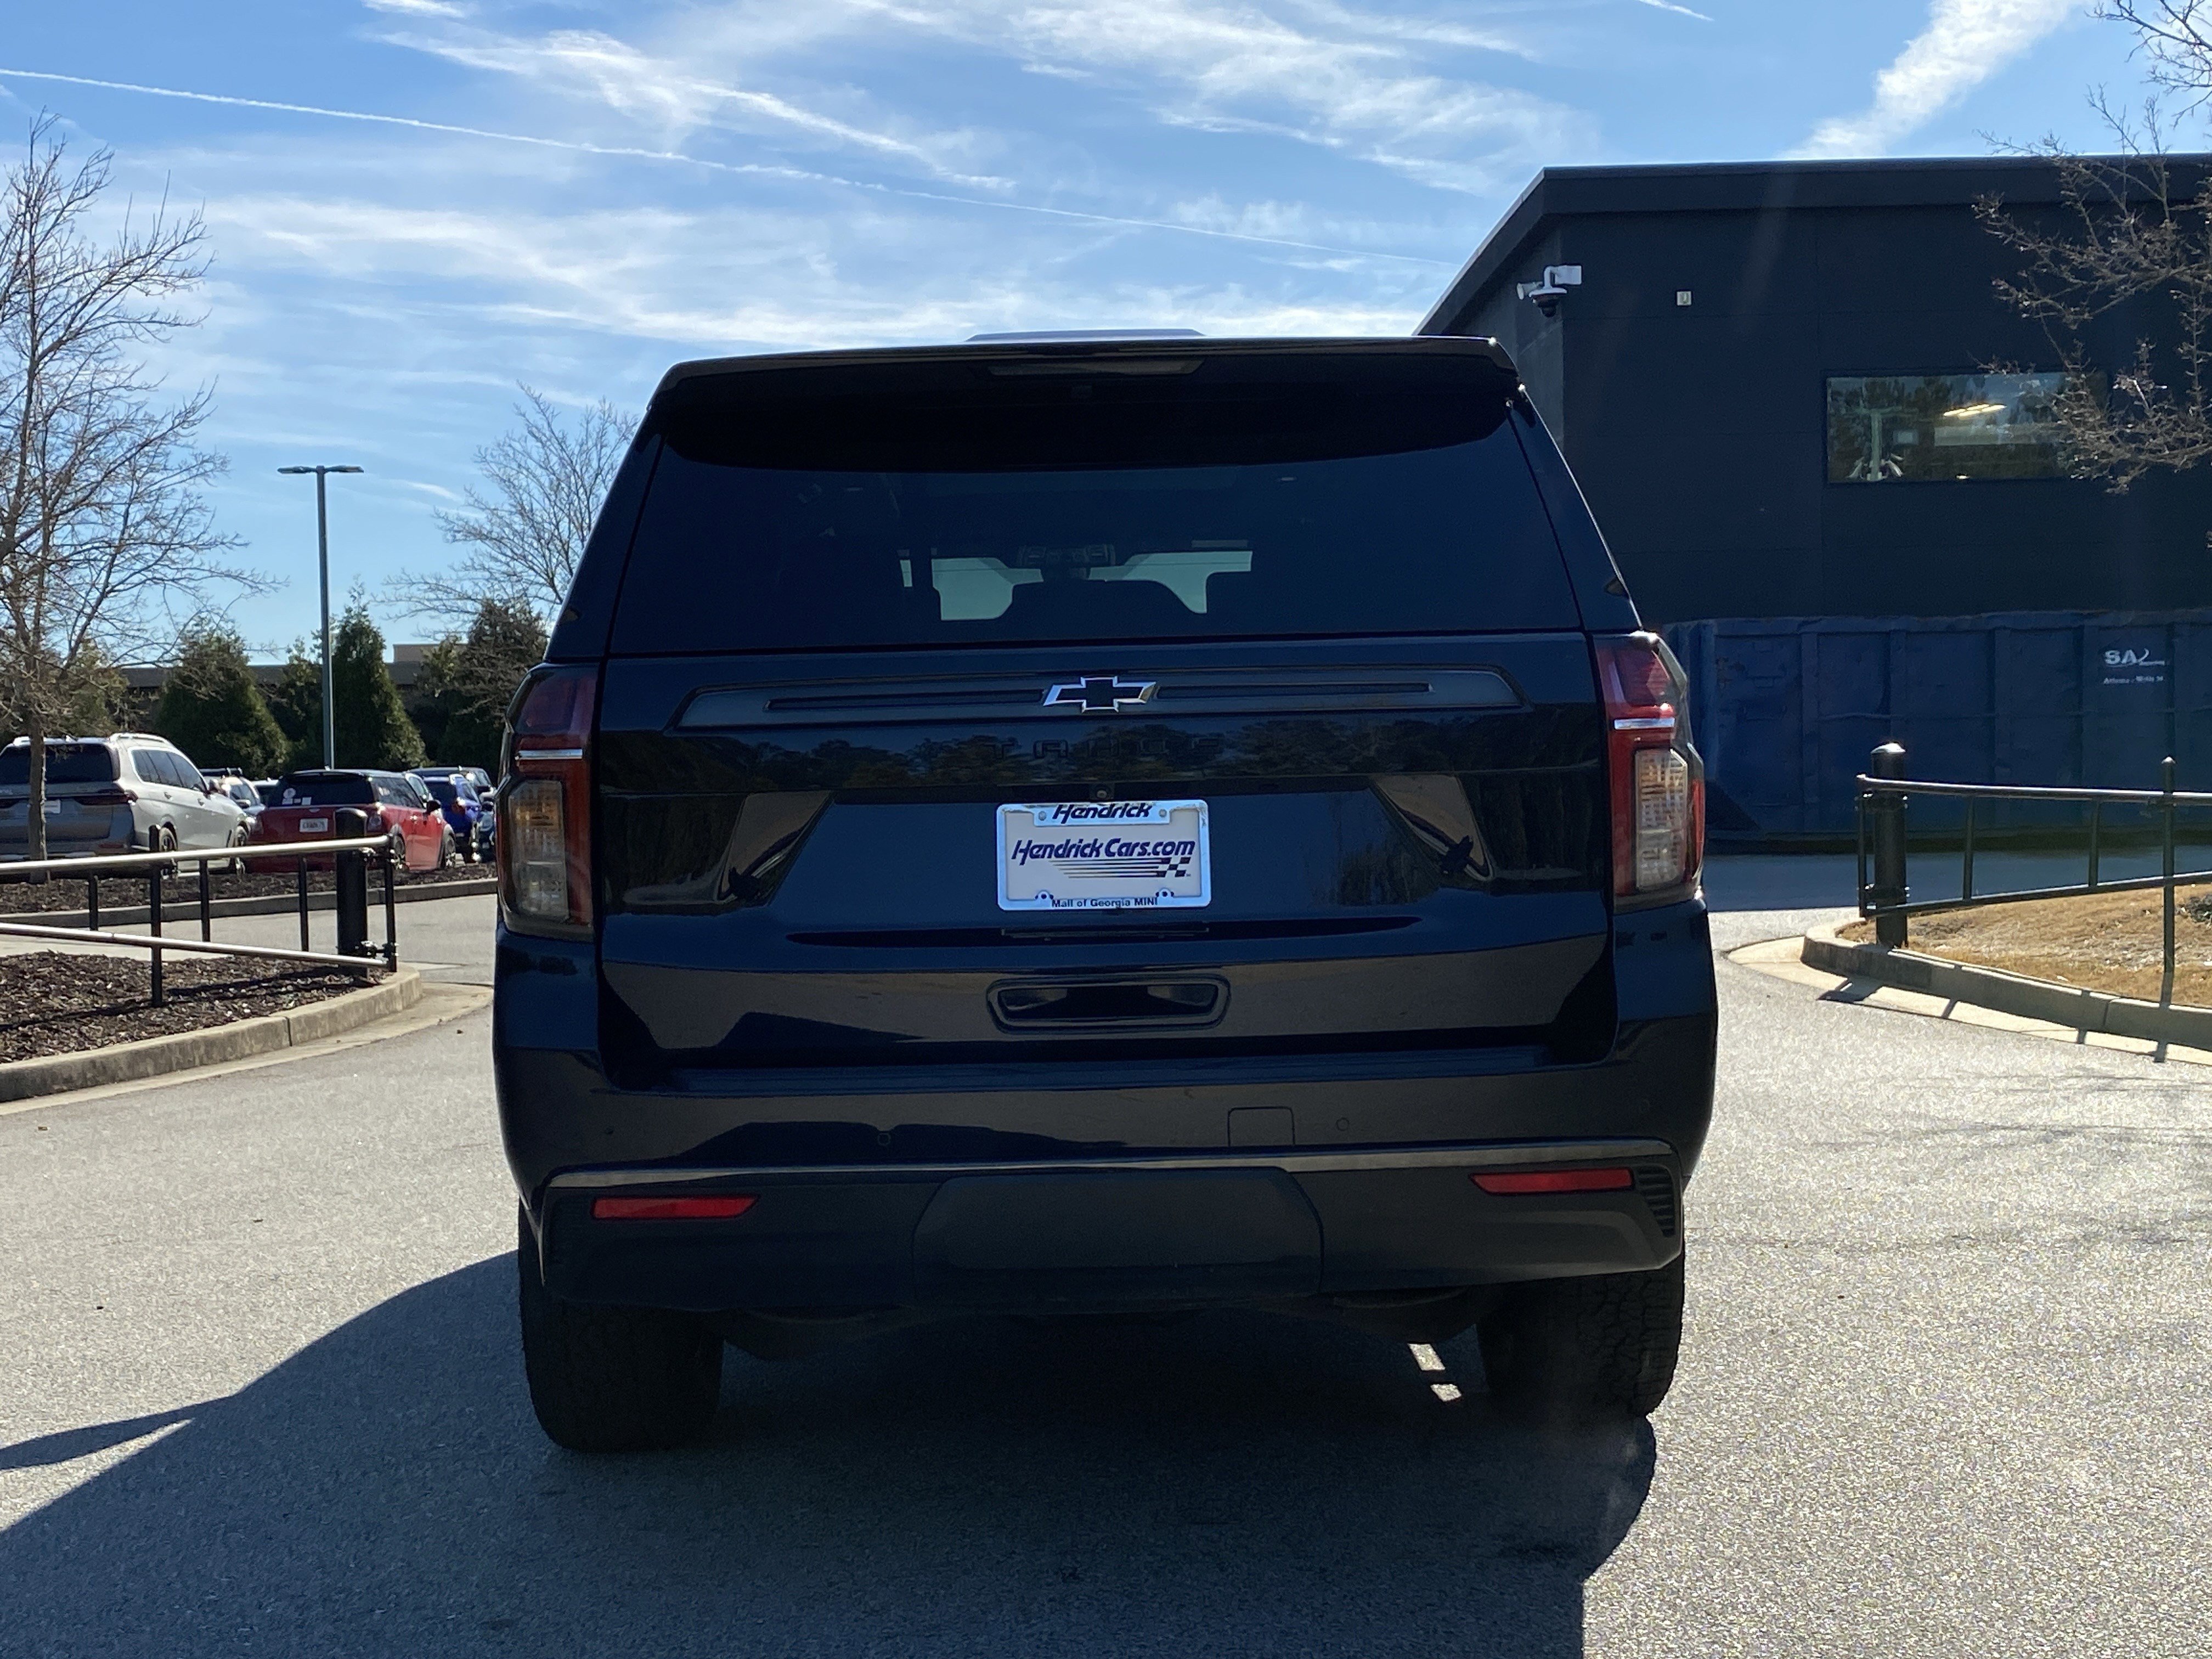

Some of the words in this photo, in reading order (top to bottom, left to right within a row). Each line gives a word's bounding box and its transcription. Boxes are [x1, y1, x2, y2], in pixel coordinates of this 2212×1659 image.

[1052, 803, 1153, 824] Hendrick
[1052, 899, 1073, 908] Mall
[1077, 899, 1087, 908] of
[1090, 898, 1131, 908] Georgia
[1134, 896, 1158, 906] MINI
